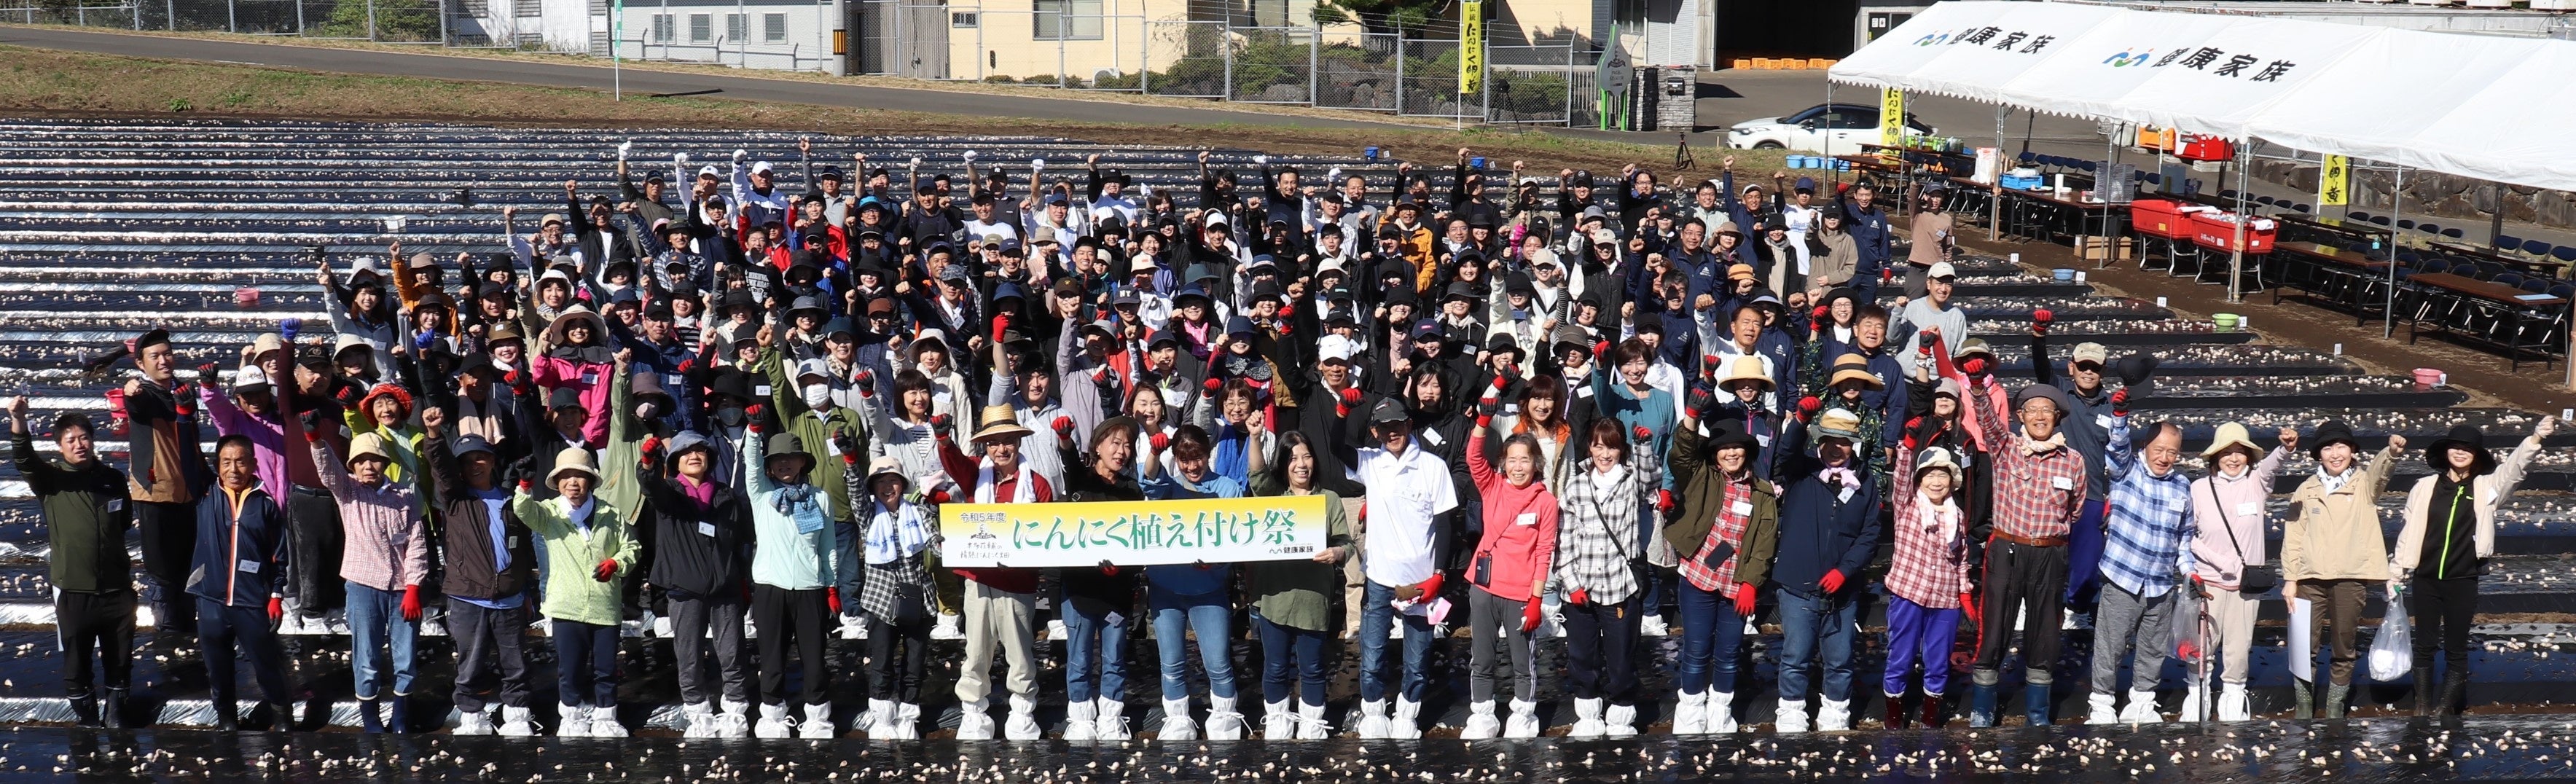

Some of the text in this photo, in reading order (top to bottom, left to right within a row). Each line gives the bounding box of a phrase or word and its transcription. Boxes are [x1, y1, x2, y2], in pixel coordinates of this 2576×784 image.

[1946, 26, 2056, 55] 健康家族
[2150, 46, 2296, 83] 健康家族
[1119, 289, 1131, 297] NY
[2566, 411, 2571, 419] 9
[960, 512, 1007, 522] 令和5年度
[1012, 508, 1296, 551] にんにく植え付け祭
[1283, 546, 1313, 554] 健康家族
